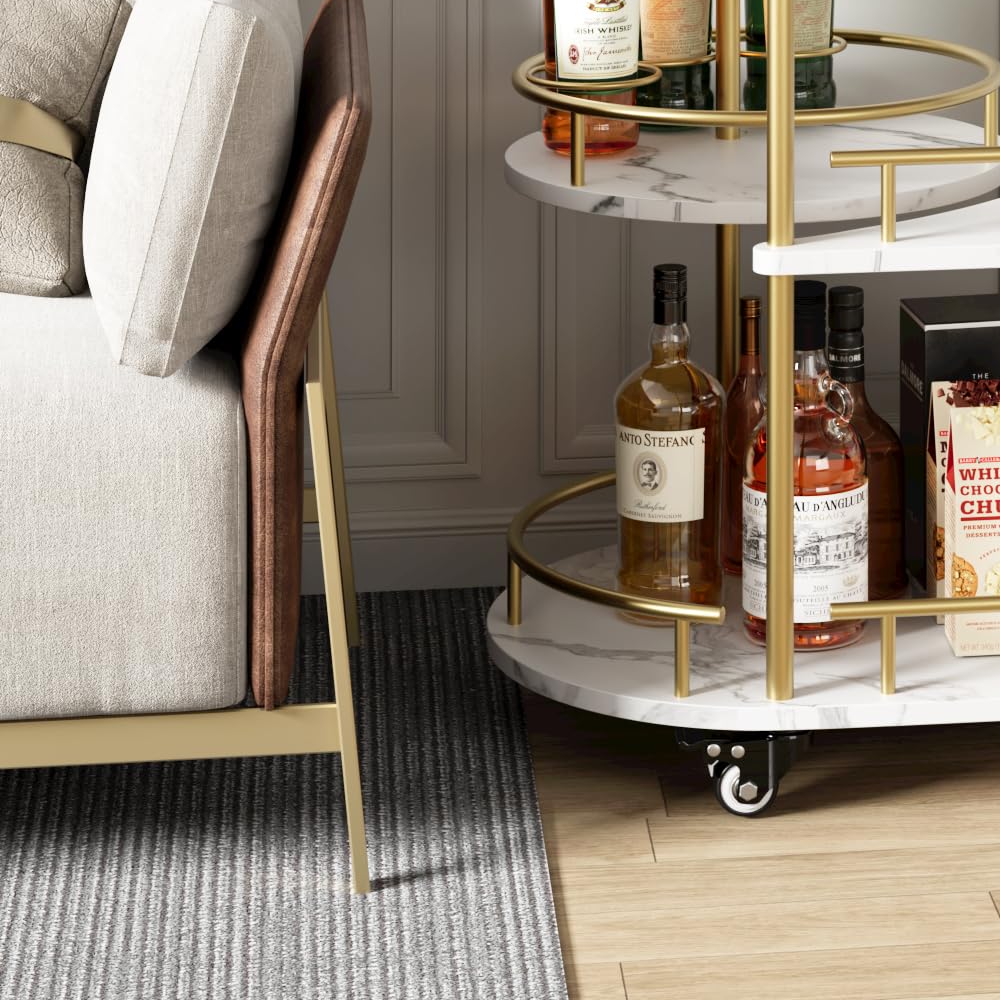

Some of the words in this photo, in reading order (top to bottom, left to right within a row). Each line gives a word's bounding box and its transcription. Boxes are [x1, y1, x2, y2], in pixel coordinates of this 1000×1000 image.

[576, 26, 594, 35] RISH
[598, 24, 633, 34] WHISKEY
[619, 431, 642, 446] ANTO
